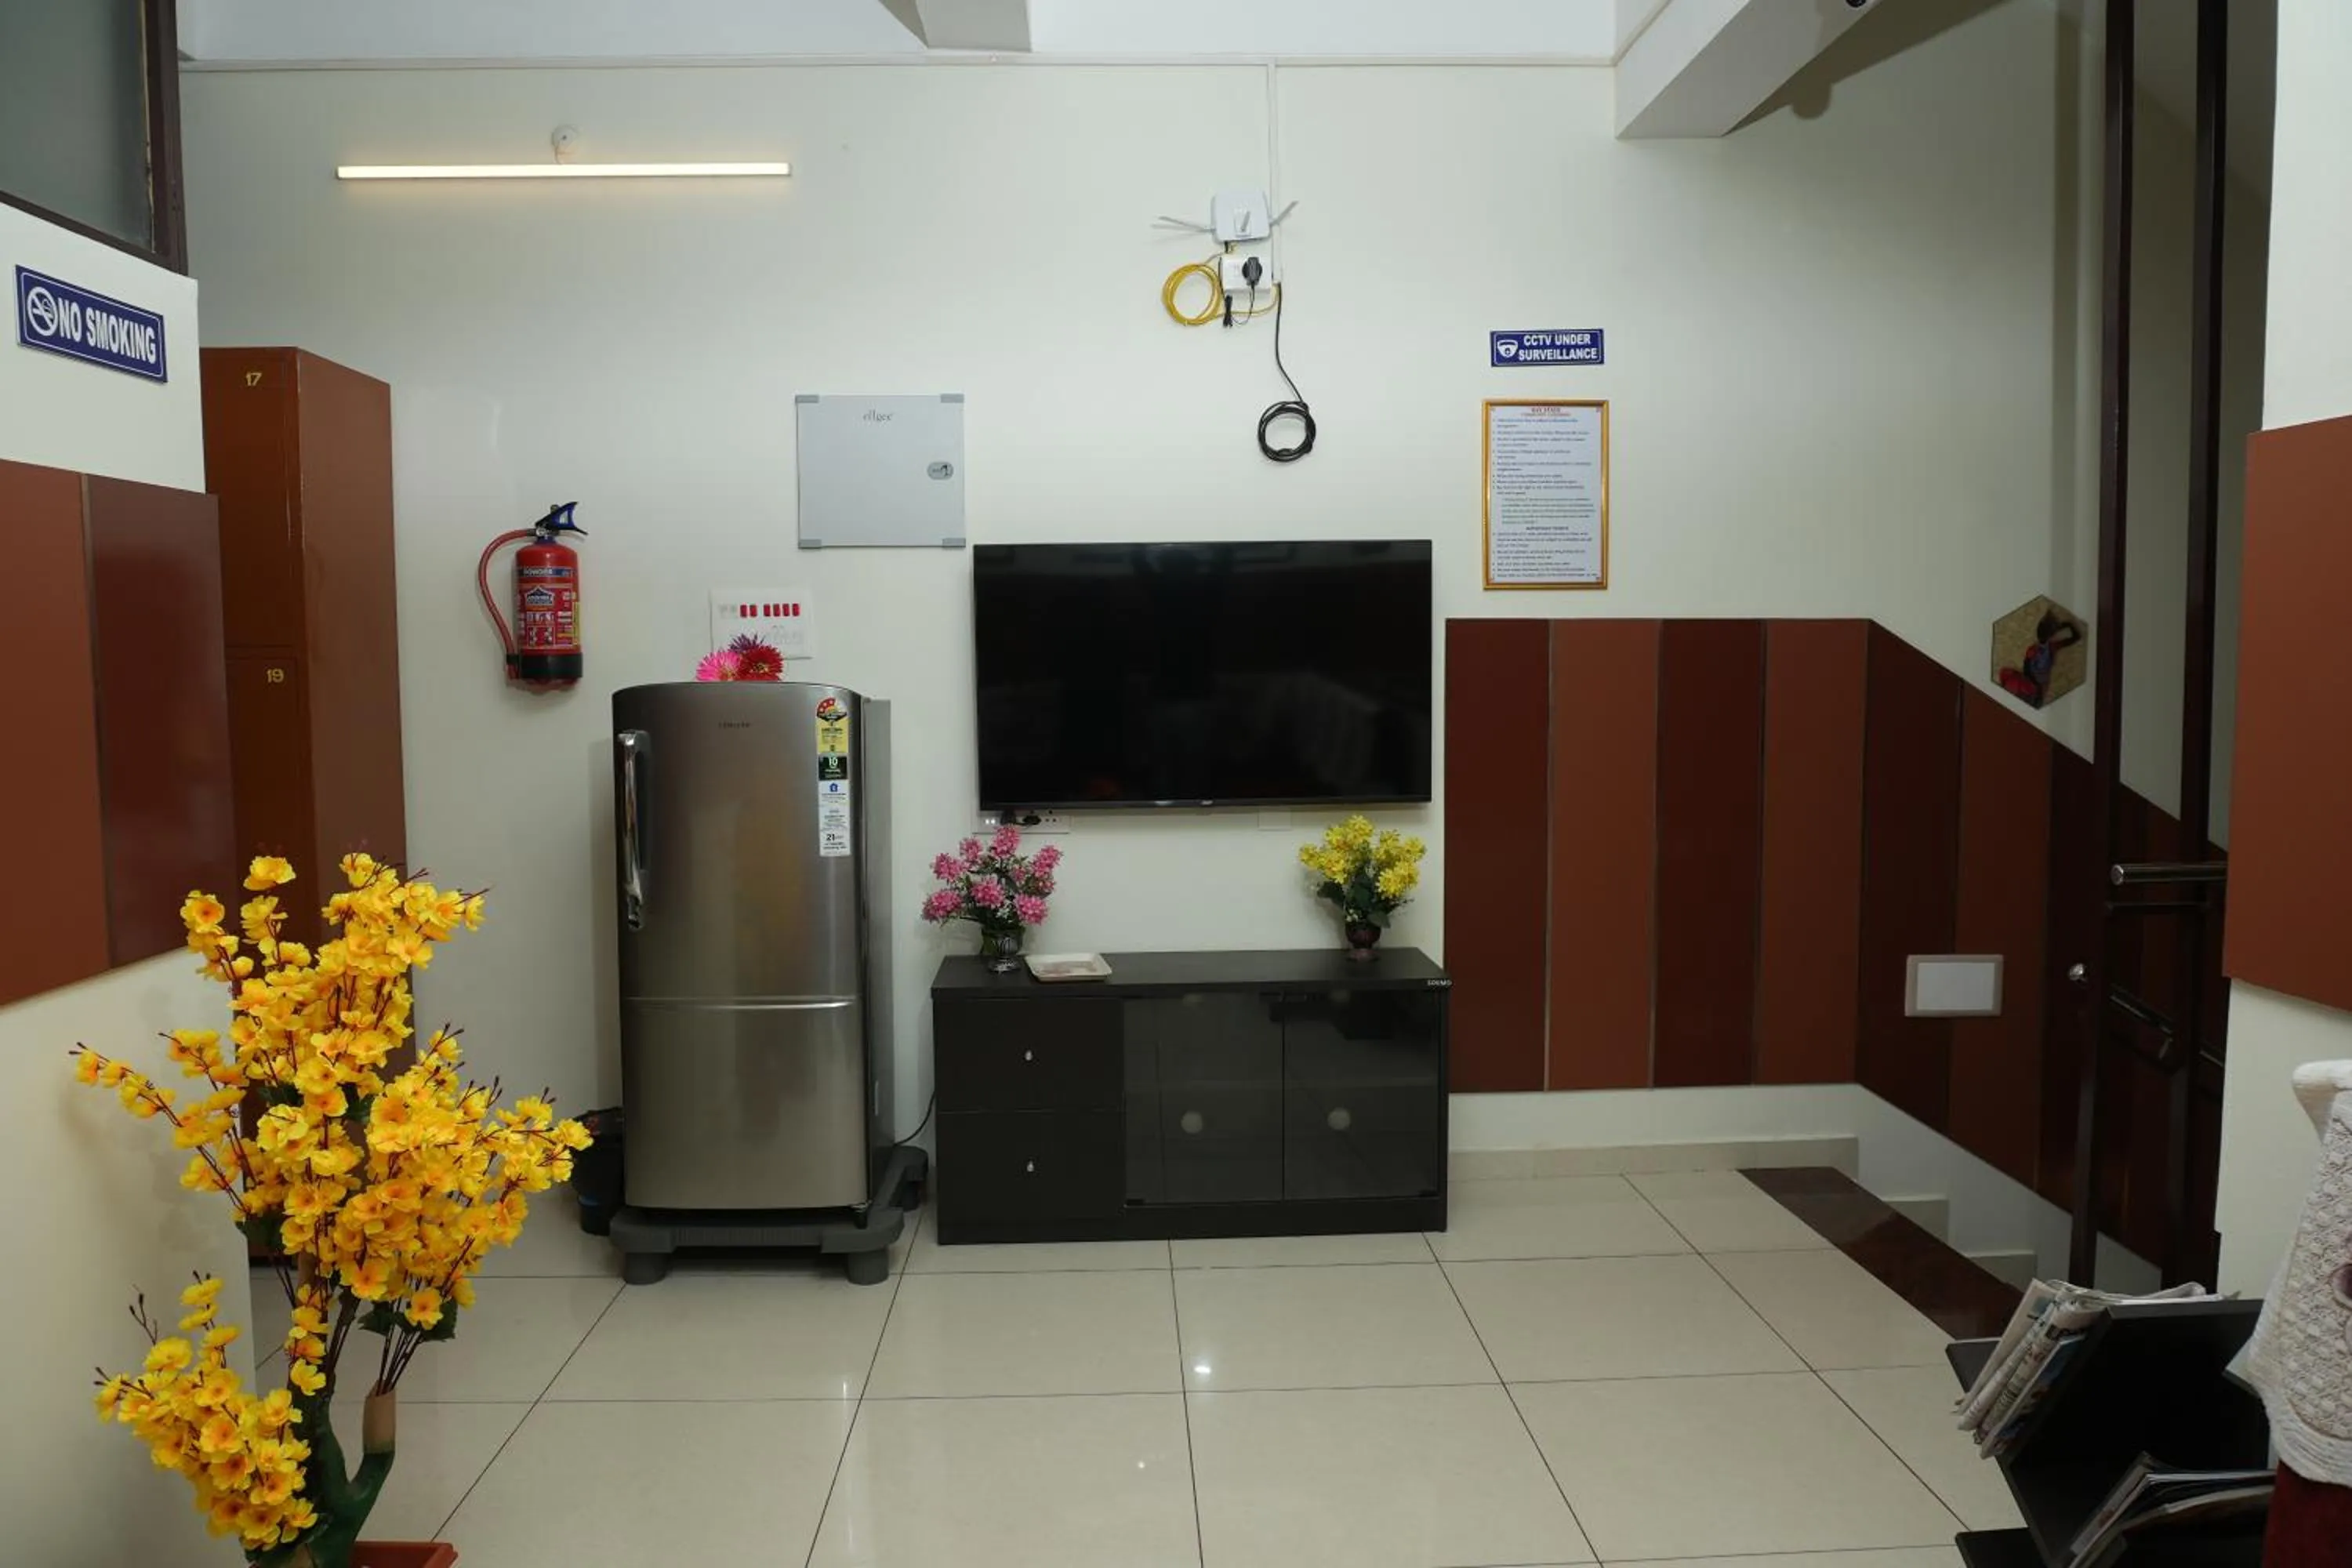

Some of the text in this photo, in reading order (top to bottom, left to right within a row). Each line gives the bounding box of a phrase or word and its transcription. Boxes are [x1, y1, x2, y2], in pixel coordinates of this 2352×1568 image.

[57, 297, 157, 365] NO SMOKING
[1523, 333, 1591, 346] CCTV UNDER
[1518, 347, 1598, 361] SURVEILLANCE
[245, 372, 262, 387] 17
[267, 668, 285, 683] 19
